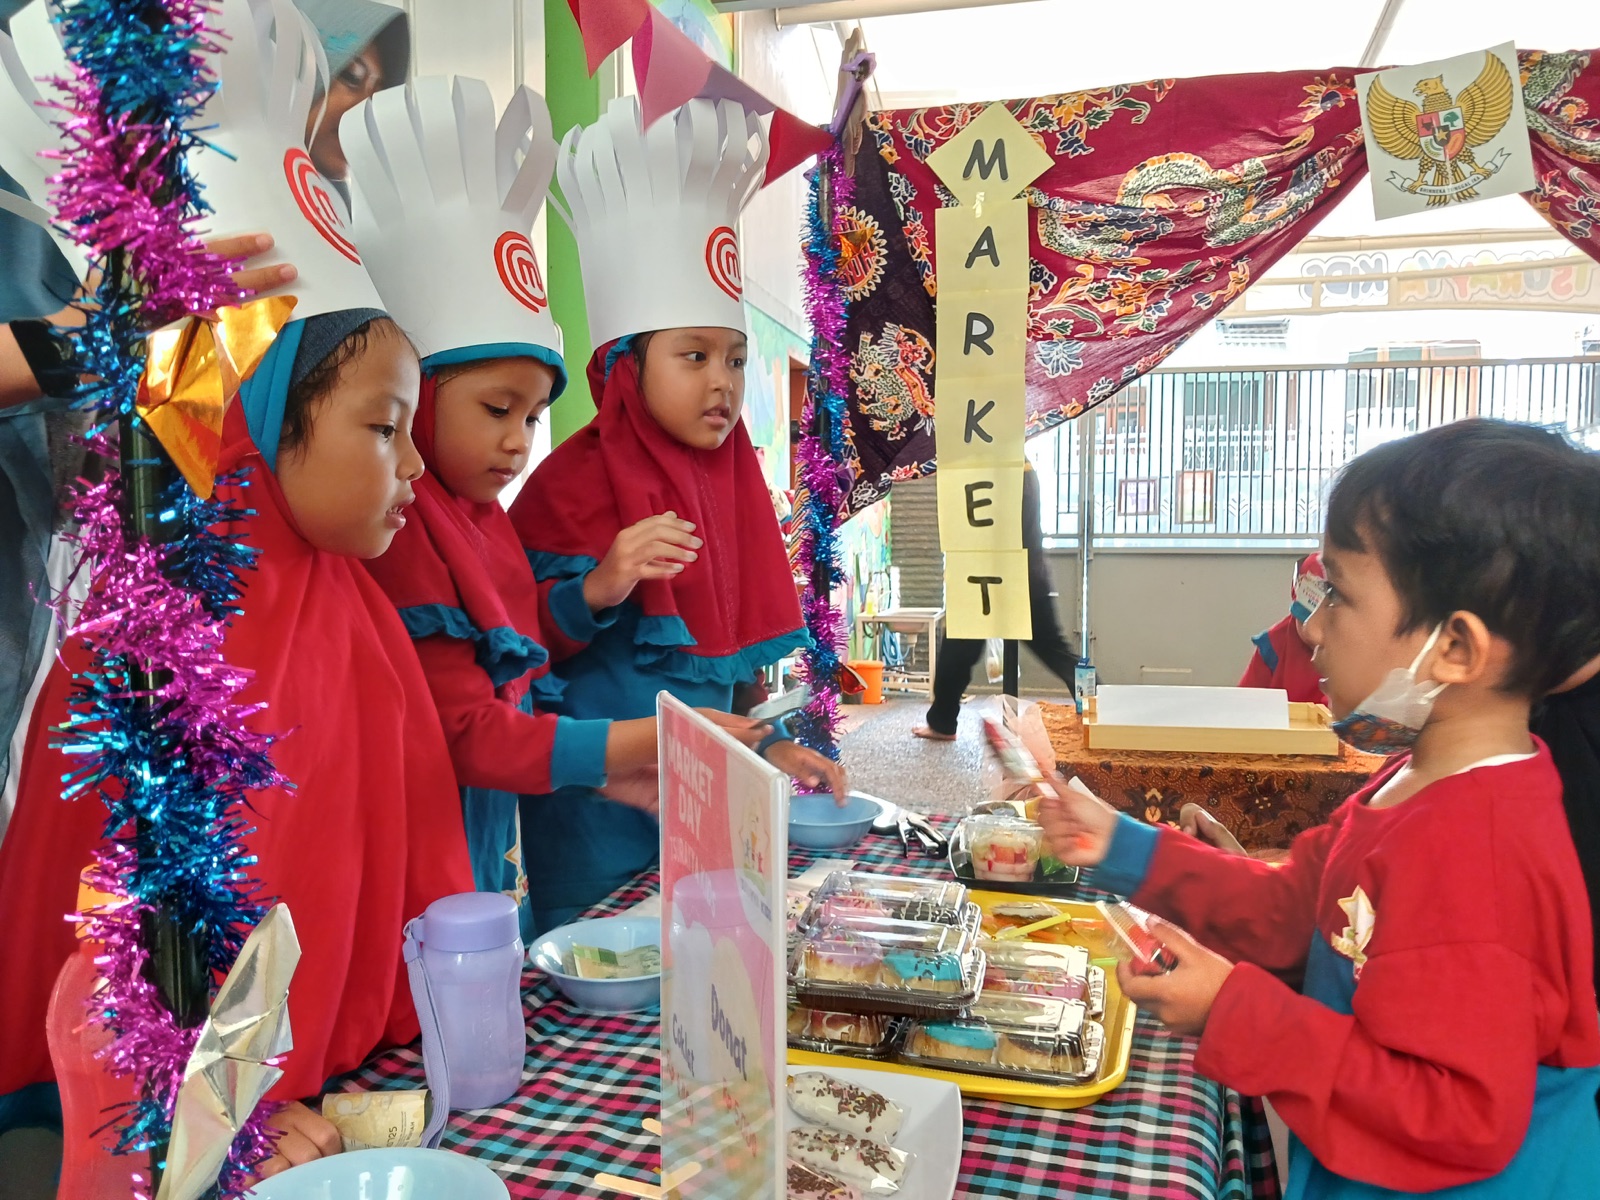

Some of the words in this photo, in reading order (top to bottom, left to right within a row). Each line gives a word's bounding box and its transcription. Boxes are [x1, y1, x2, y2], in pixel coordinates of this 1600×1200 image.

[961, 136, 1010, 617] MARKET
[667, 733, 714, 808] MARKET
[678, 785, 702, 840] DAY
[711, 983, 749, 1082] Donat
